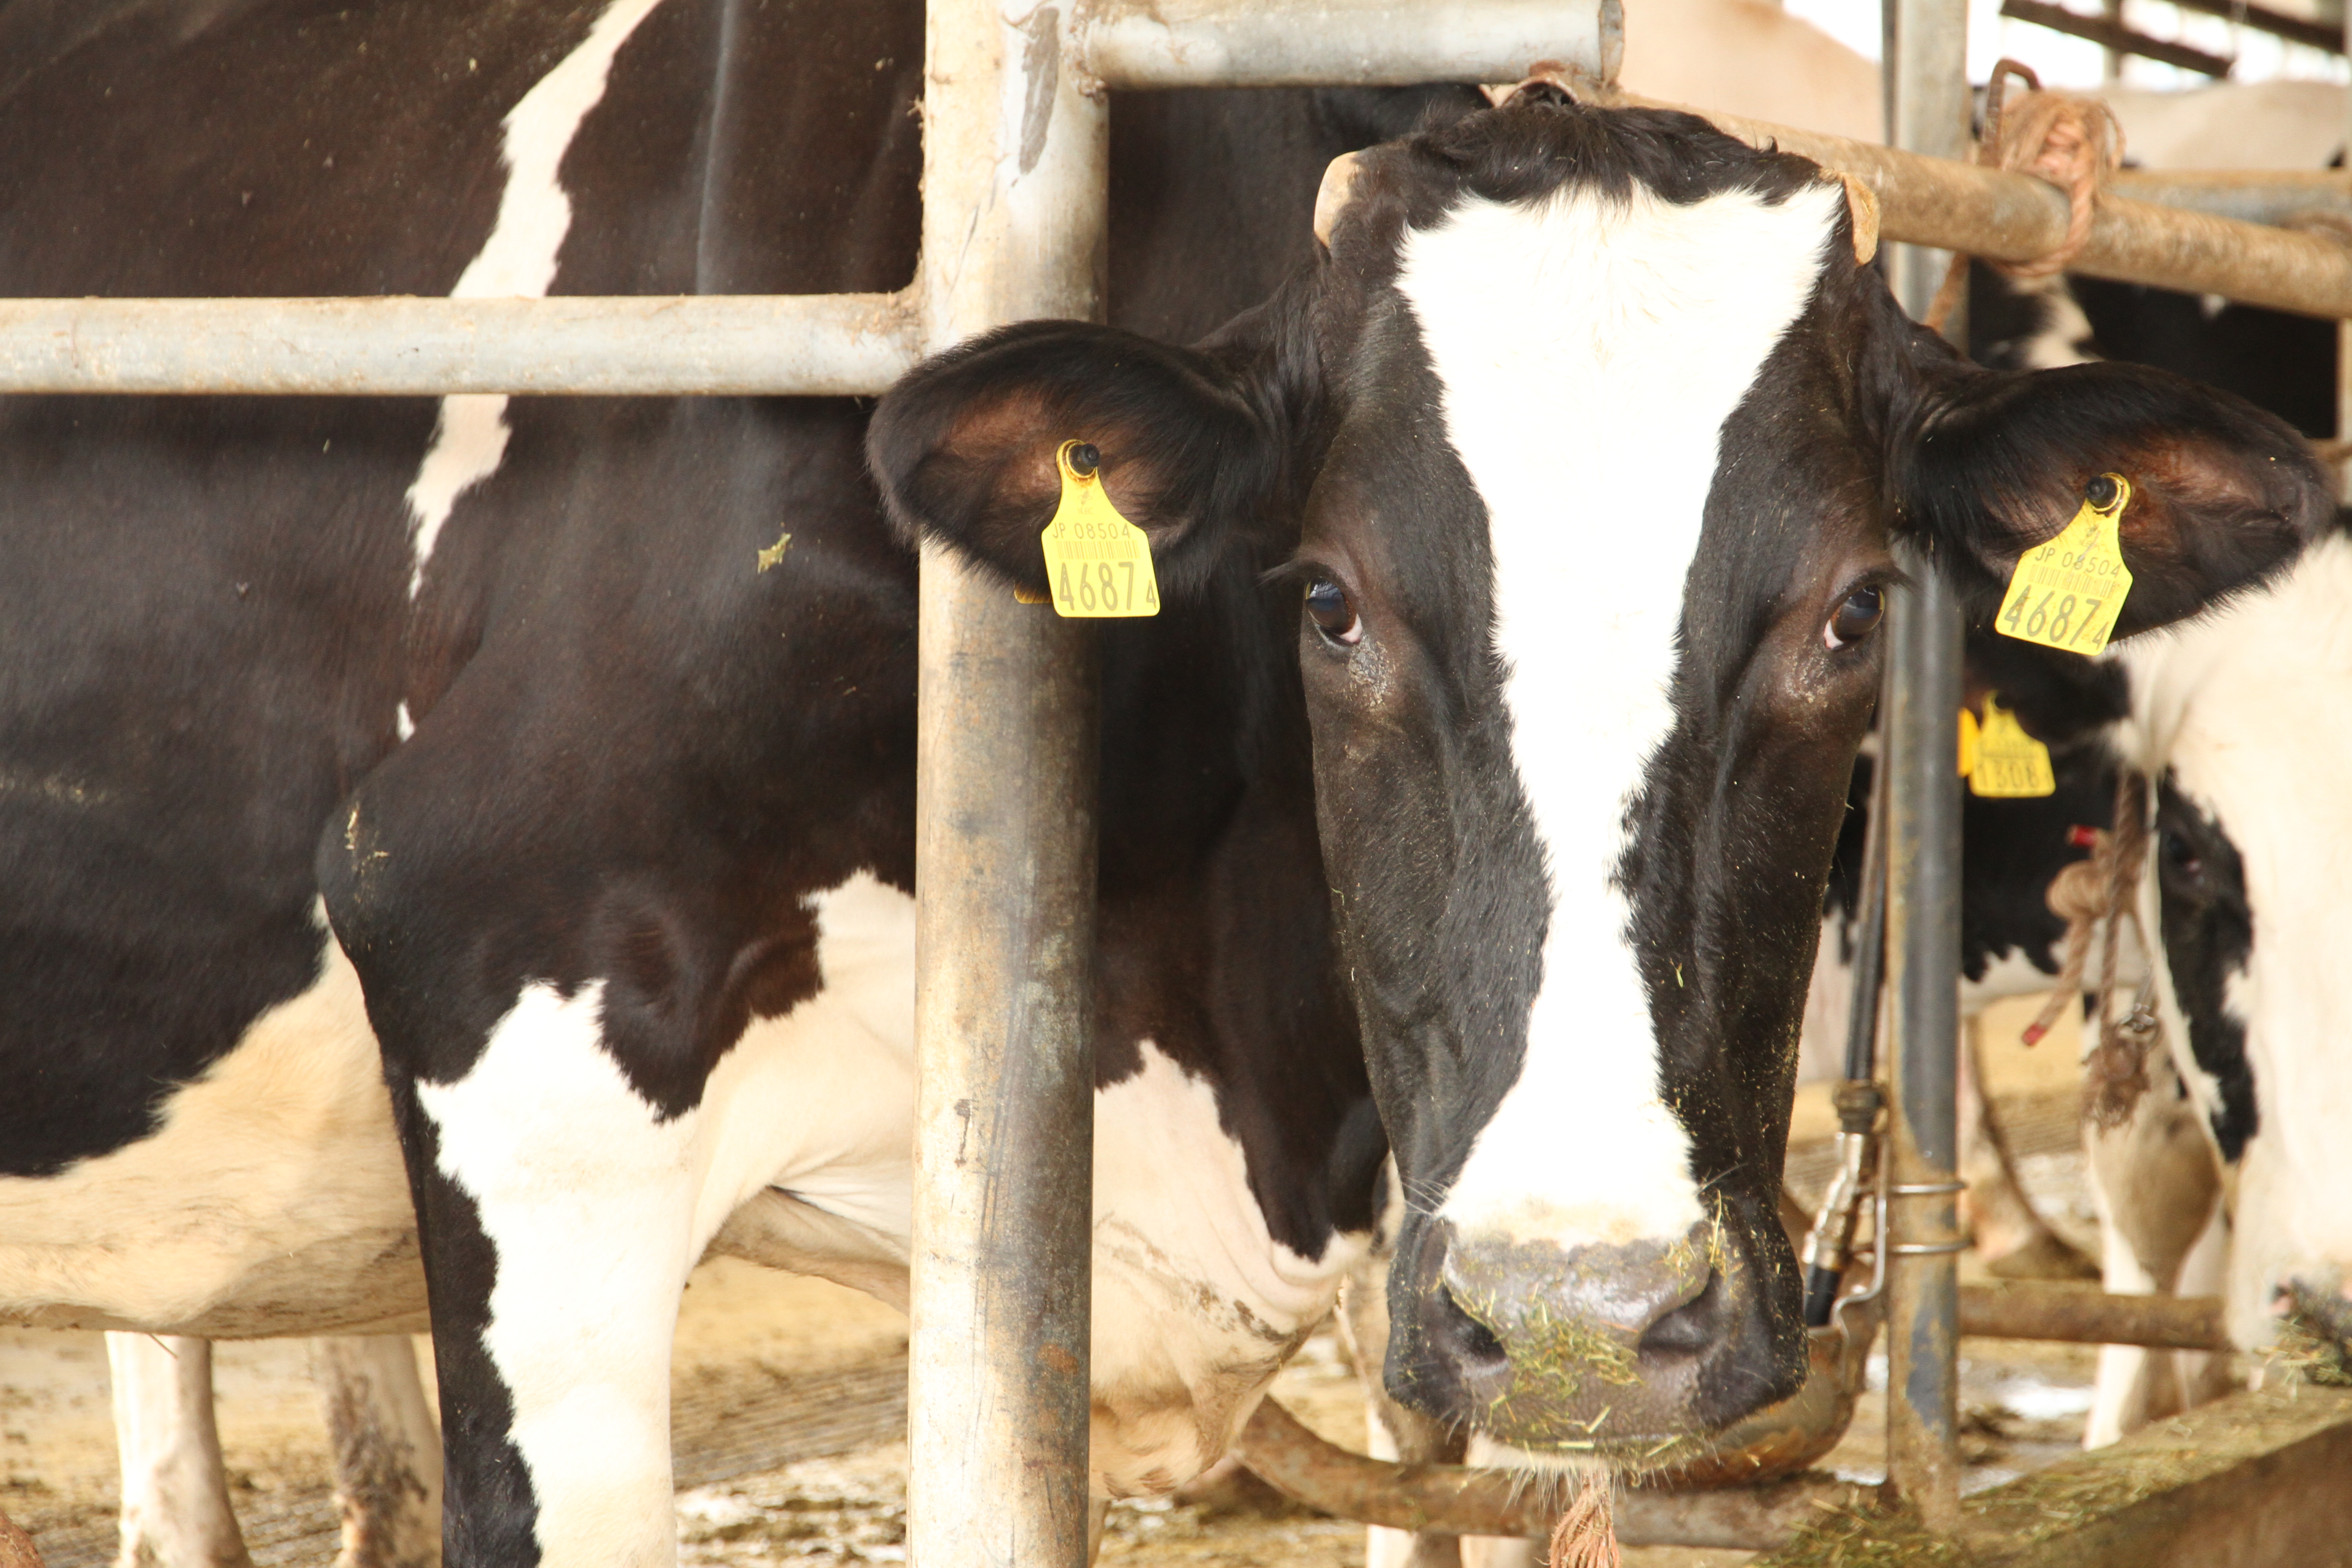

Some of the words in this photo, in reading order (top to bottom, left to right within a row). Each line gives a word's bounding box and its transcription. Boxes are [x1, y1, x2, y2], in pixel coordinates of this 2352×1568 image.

[1052, 522, 1066, 539] JP
[1074, 523, 1130, 539] 08504
[2035, 546, 2056, 562] JP
